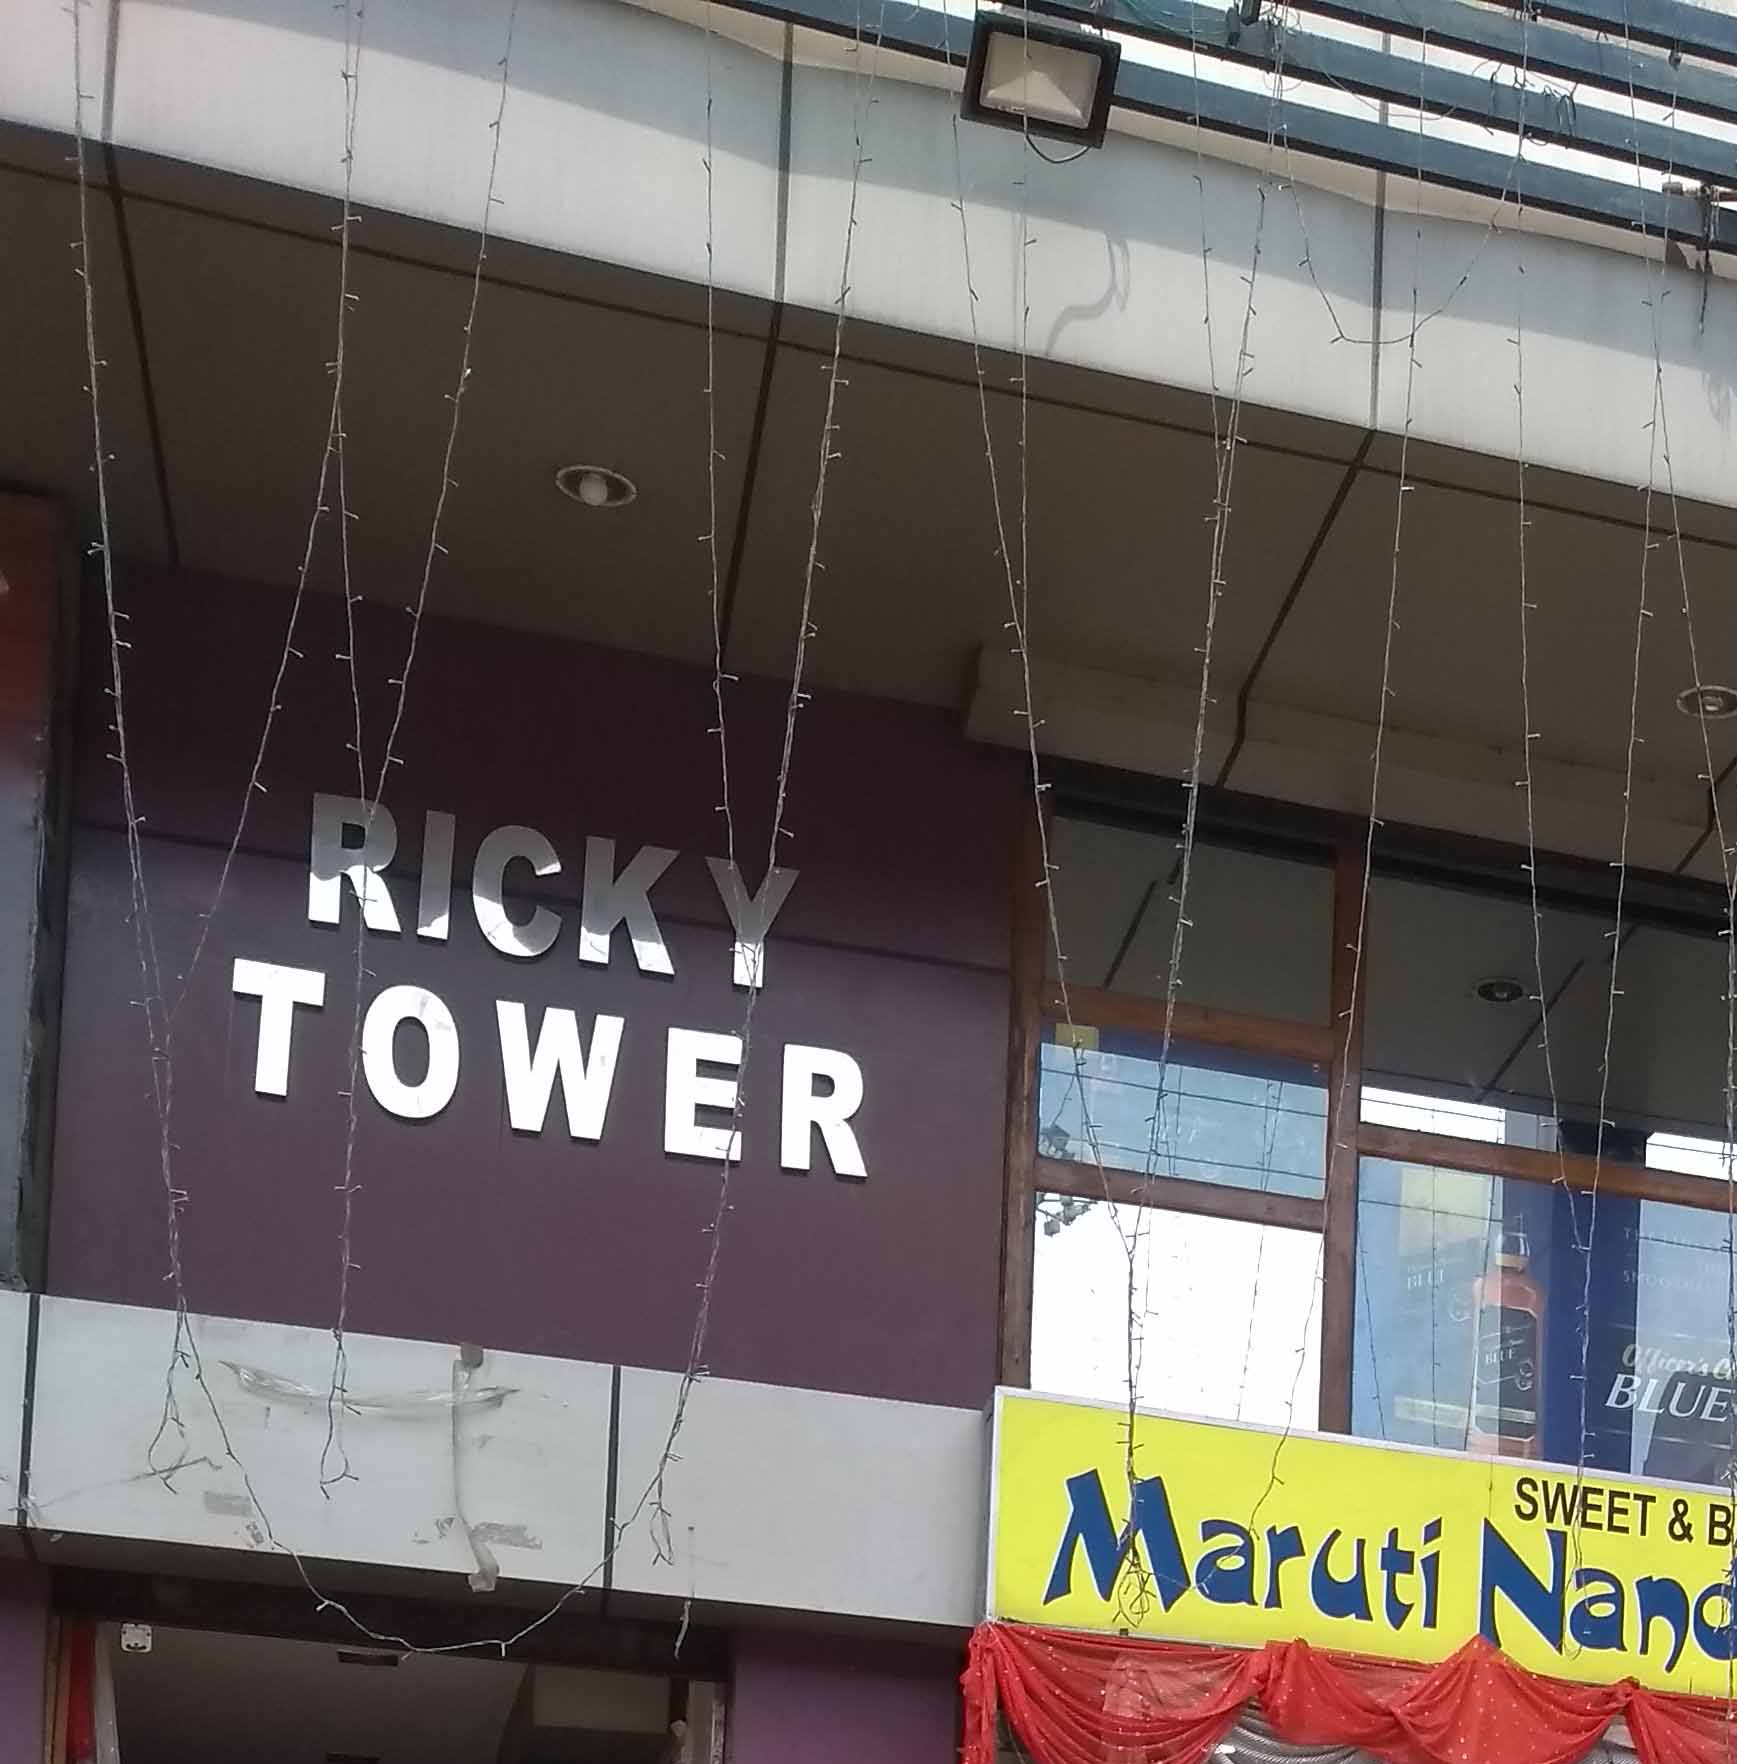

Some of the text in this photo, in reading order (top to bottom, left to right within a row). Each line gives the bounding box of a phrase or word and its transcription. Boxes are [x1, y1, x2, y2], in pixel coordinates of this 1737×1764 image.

[307, 792, 800, 990] RICKY
[232, 958, 868, 1179] TOWER
[1604, 1371, 1737, 1423] BLUE
[1043, 1467, 1443, 1631] Maruti
[1514, 1477, 1657, 1538] SWEET
[1668, 1498, 1694, 1544] &
